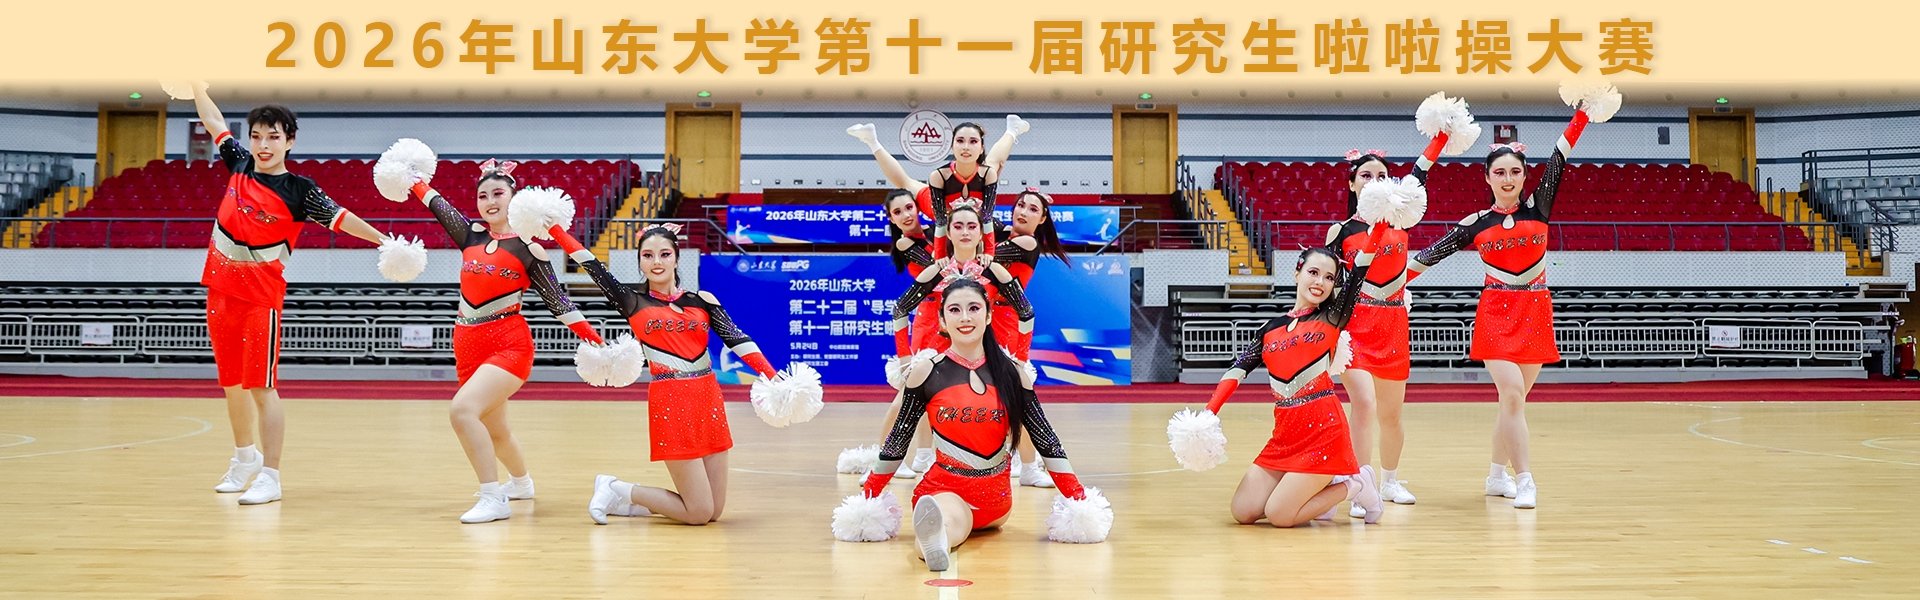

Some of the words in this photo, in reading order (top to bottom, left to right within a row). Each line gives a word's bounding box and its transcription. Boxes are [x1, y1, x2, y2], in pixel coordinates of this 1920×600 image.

[765, 210, 889, 222] 2026年山东大学第二十
[789, 278, 876, 292] 2026年山东大学
[790, 342, 818, 350] 5月24日
[936, 406, 1005, 424] CHEER
